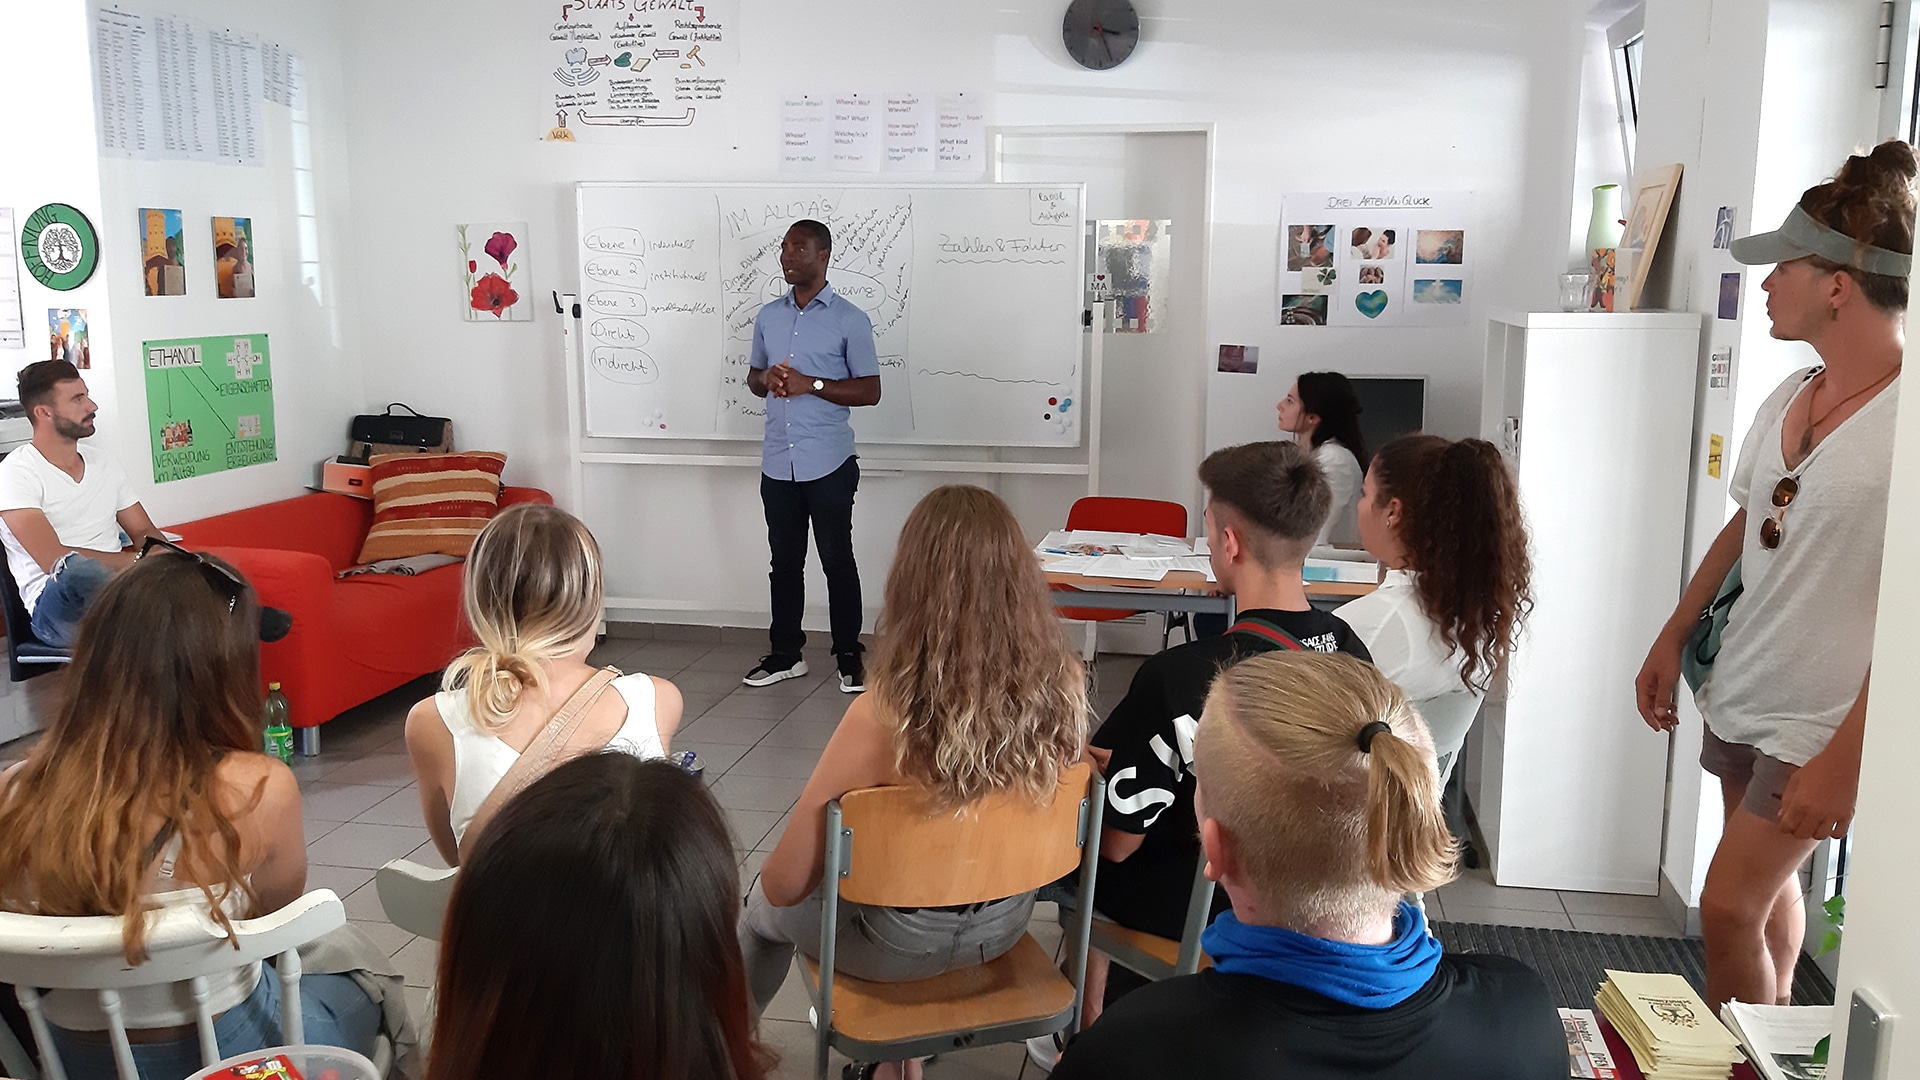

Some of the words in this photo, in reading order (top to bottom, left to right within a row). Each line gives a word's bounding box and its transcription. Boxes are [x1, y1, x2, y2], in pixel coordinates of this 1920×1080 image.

[1327, 196, 1352, 208] DREI
[726, 208, 752, 239] IM
[22, 205, 58, 286] HOFFNUNG
[586, 235, 625, 249] Ebene
[939, 233, 994, 254] Zahlen
[1006, 237, 1068, 253] Fakten
[587, 263, 622, 277] Ebene
[629, 262, 638, 276] 2
[1091, 283, 1107, 291] MA
[588, 294, 619, 307] Ebene
[629, 297, 637, 309] 3
[149, 346, 201, 368] ETHANOL
[220, 379, 272, 397] EIGENSCHAFTEN
[155, 449, 210, 468] VERWENDUNG
[227, 451, 274, 469] ERZEUGUNG
[172, 466, 195, 481] Alltag
